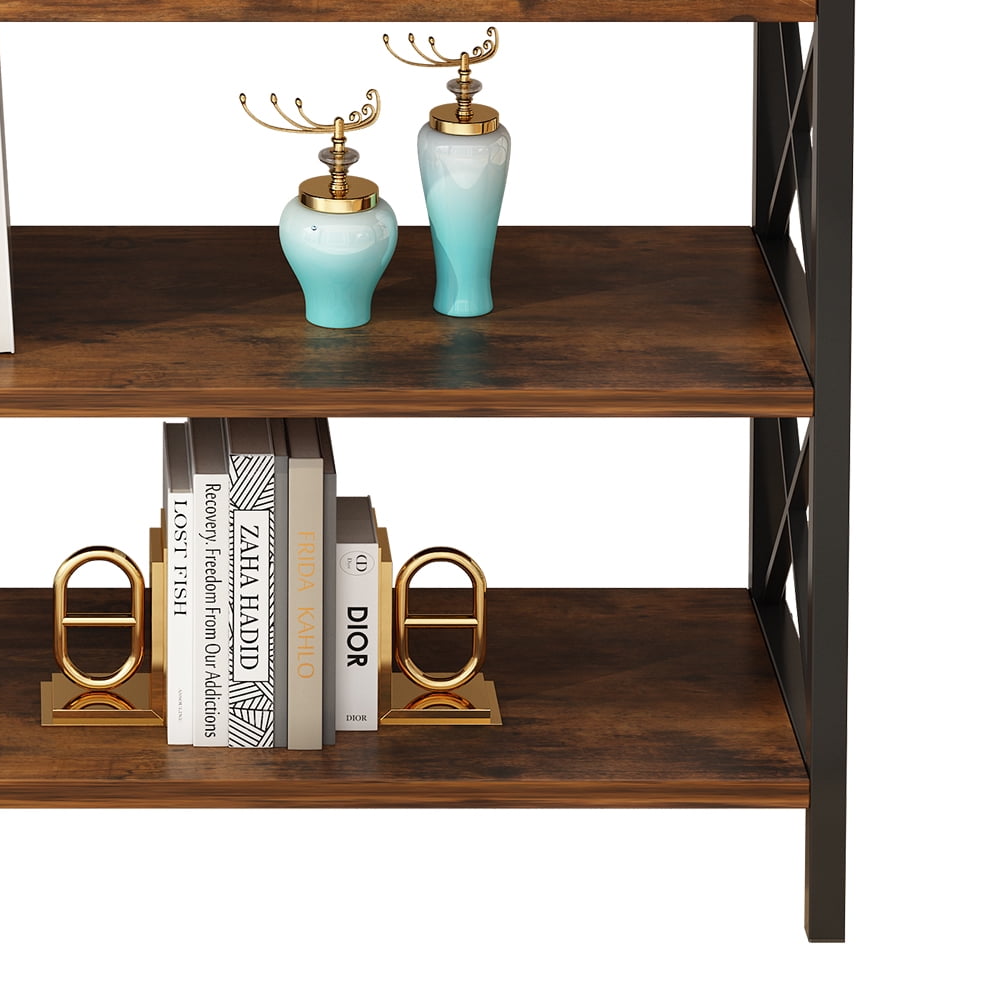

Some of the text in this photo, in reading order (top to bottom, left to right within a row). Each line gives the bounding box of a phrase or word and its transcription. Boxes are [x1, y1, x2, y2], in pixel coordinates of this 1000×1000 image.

[173, 499, 188, 617] LOST FISH
[199, 483, 223, 738] Recovery. Freedom From Our Addictions
[239, 524, 260, 670] ZAHA HADID
[297, 531, 316, 680] FRIDA KAHLO
[346, 606, 369, 668] DIOR
[345, 714, 368, 722] DIOR
